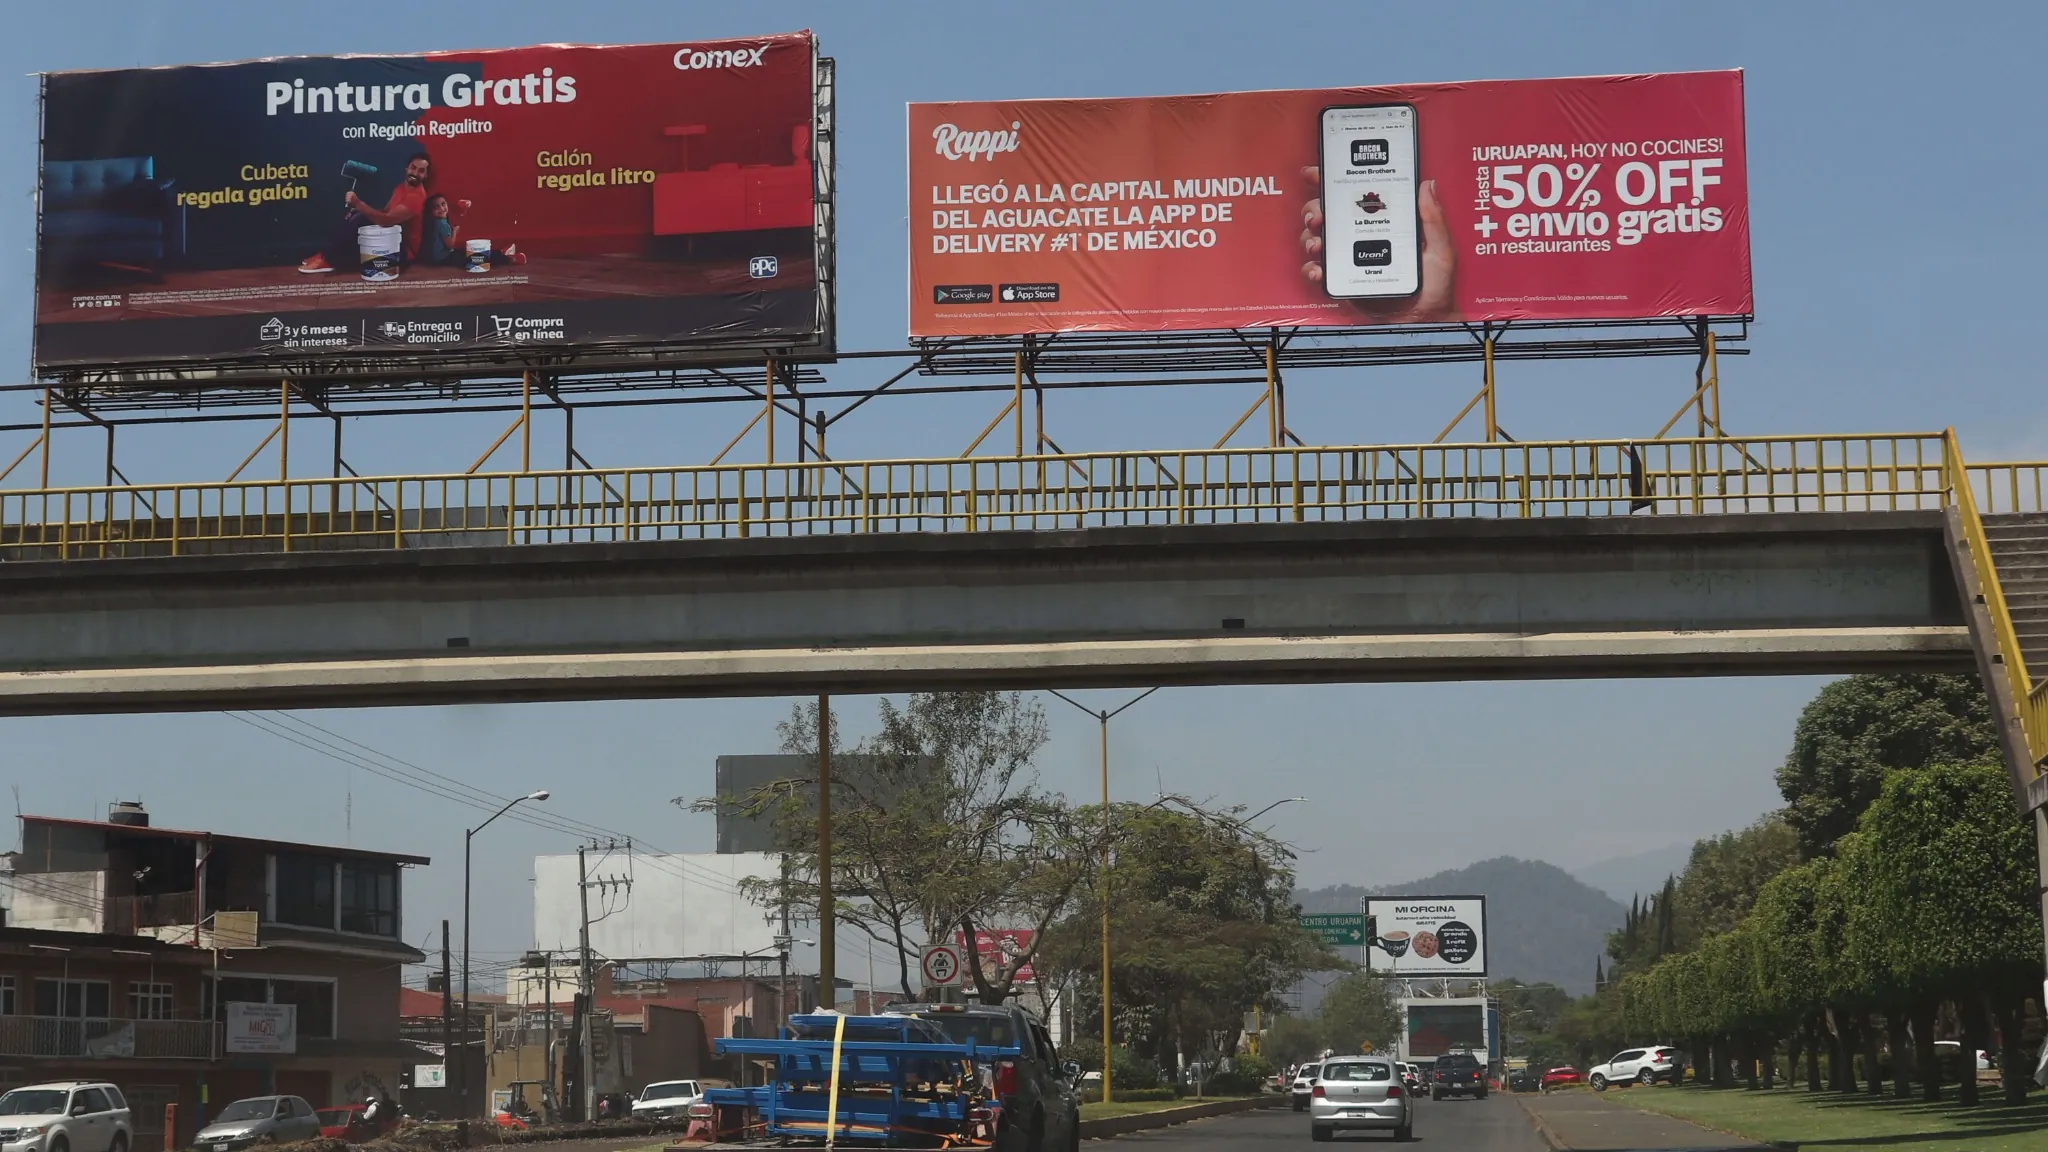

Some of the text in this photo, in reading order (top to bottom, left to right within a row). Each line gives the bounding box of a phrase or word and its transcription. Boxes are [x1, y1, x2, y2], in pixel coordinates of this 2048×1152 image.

[674, 42, 772, 70] Comex
[266, 67, 577, 116] Pintura Gratis
[343, 118, 493, 141] con Regalón Regalitro
[933, 121, 1021, 162] Rappi
[1359, 144, 1381, 153] BACON
[1472, 138, 1724, 161] ¡URUAPAN, HOY NO COCINES!
[537, 149, 592, 168] Galón
[1354, 151, 1387, 162] BROTHERS
[240, 162, 309, 182] Cubeta
[537, 166, 656, 191] regala litro
[932, 176, 1283, 205] LLEGÓ A LA CAPITAL MUNDIAL
[1474, 166, 1490, 211] Hasta
[1492, 158, 1723, 209] 50% OFF
[177, 182, 308, 209] regala galón
[932, 202, 1233, 229] DEL AGUACATE LA APP DE
[1474, 196, 1723, 246] + envío gratis
[932, 234, 1045, 254] DELIVERY
[1088, 232, 1118, 251] DE
[1124, 225, 1217, 250] MÉXICO
[1476, 238, 1611, 256] en restaurantes
[1358, 248, 1388, 259] Urani
[752, 259, 776, 276] PPG
[951, 291, 991, 300] Google play
[1017, 290, 1056, 299] App Store
[284, 325, 348, 337] 3 y 6 meses
[408, 322, 462, 333] Entrega a
[515, 318, 564, 329] Compra
[284, 338, 348, 348] sin intereses
[408, 332, 460, 343] domicilio
[515, 329, 564, 340] en línea
[1410, 905, 1455, 913] OFICINA
[1300, 916, 1362, 926] CENTRO URUAPAN
